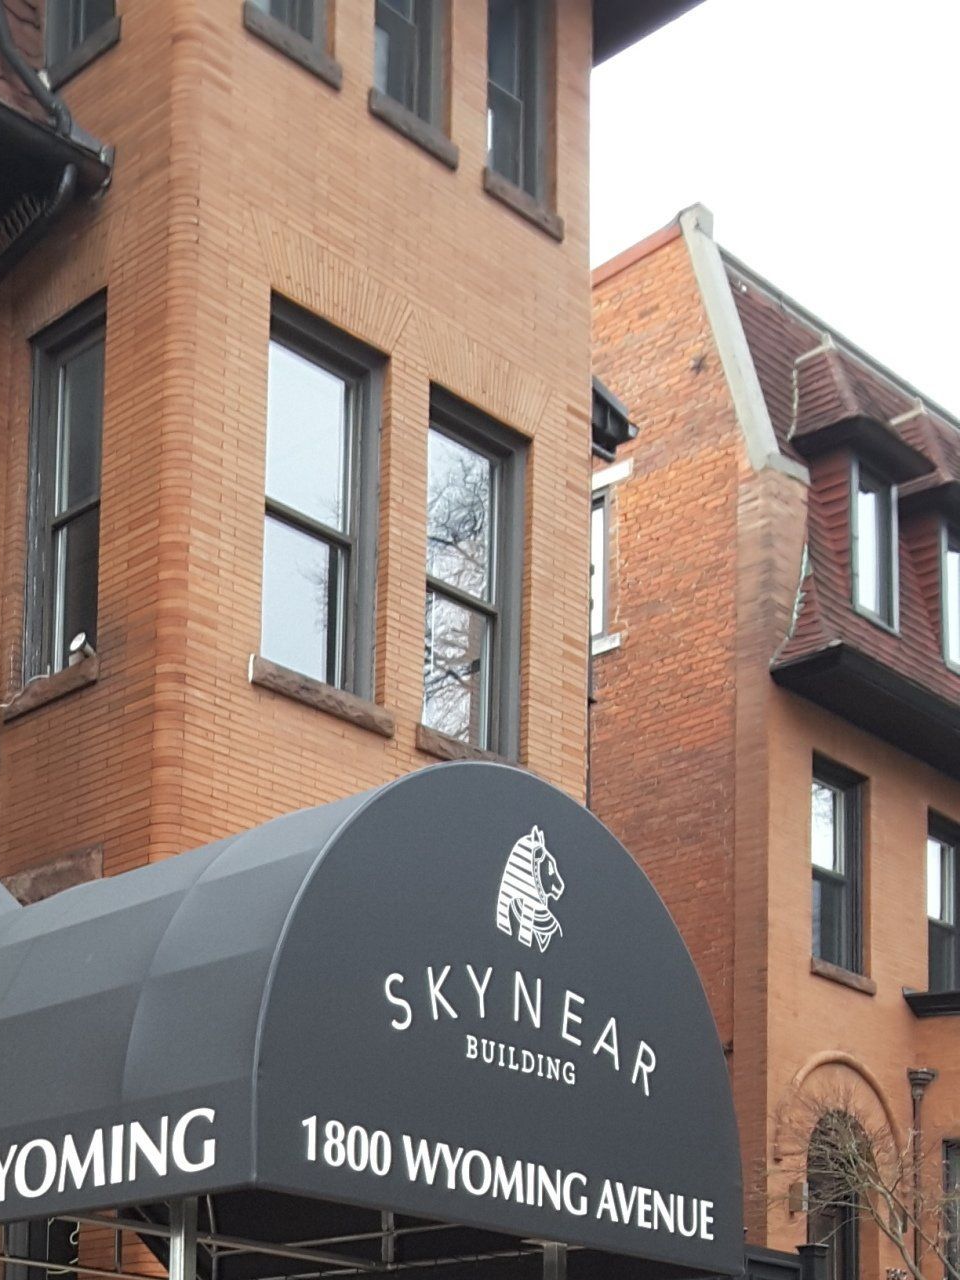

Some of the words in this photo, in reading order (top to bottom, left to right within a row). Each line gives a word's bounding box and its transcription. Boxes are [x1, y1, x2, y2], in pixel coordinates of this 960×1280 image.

[384, 964, 657, 1097] SKYNEAR
[465, 1034, 577, 1085] BUILDING
[301, 1114, 392, 1177] 1800
[402, 1134, 588, 1216] WYOMING
[596, 1178, 715, 1241] AVENUE
